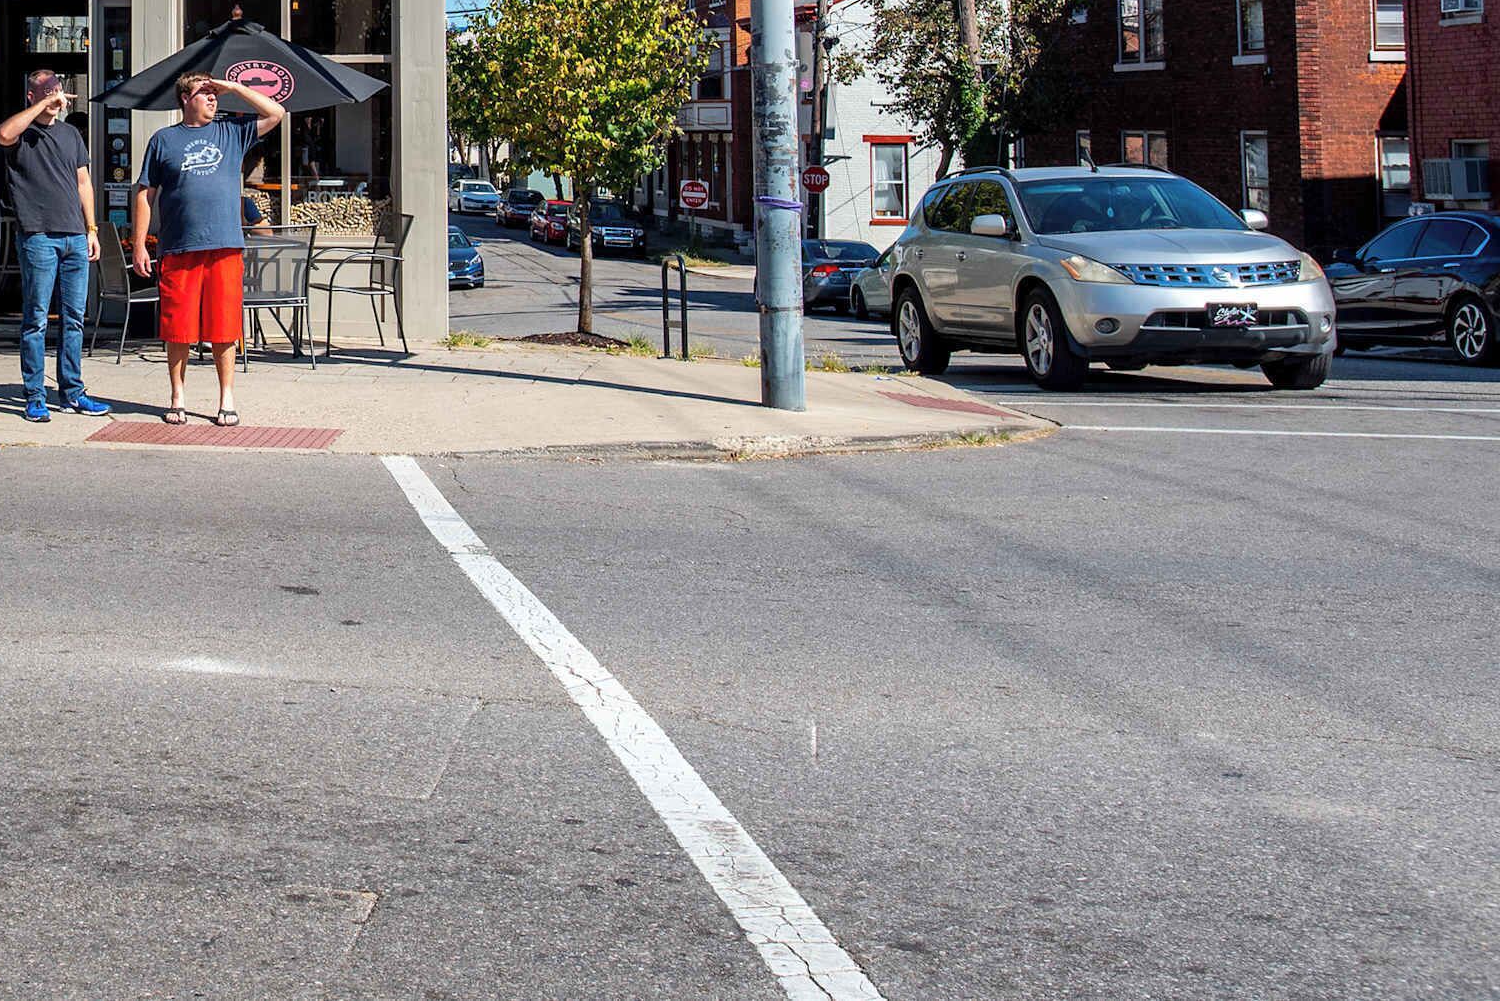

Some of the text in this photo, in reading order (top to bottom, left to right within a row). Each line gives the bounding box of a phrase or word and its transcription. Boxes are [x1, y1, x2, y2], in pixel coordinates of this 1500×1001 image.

[229, 63, 289, 81] COUNTRY BOY
[803, 173, 828, 185] STOP
